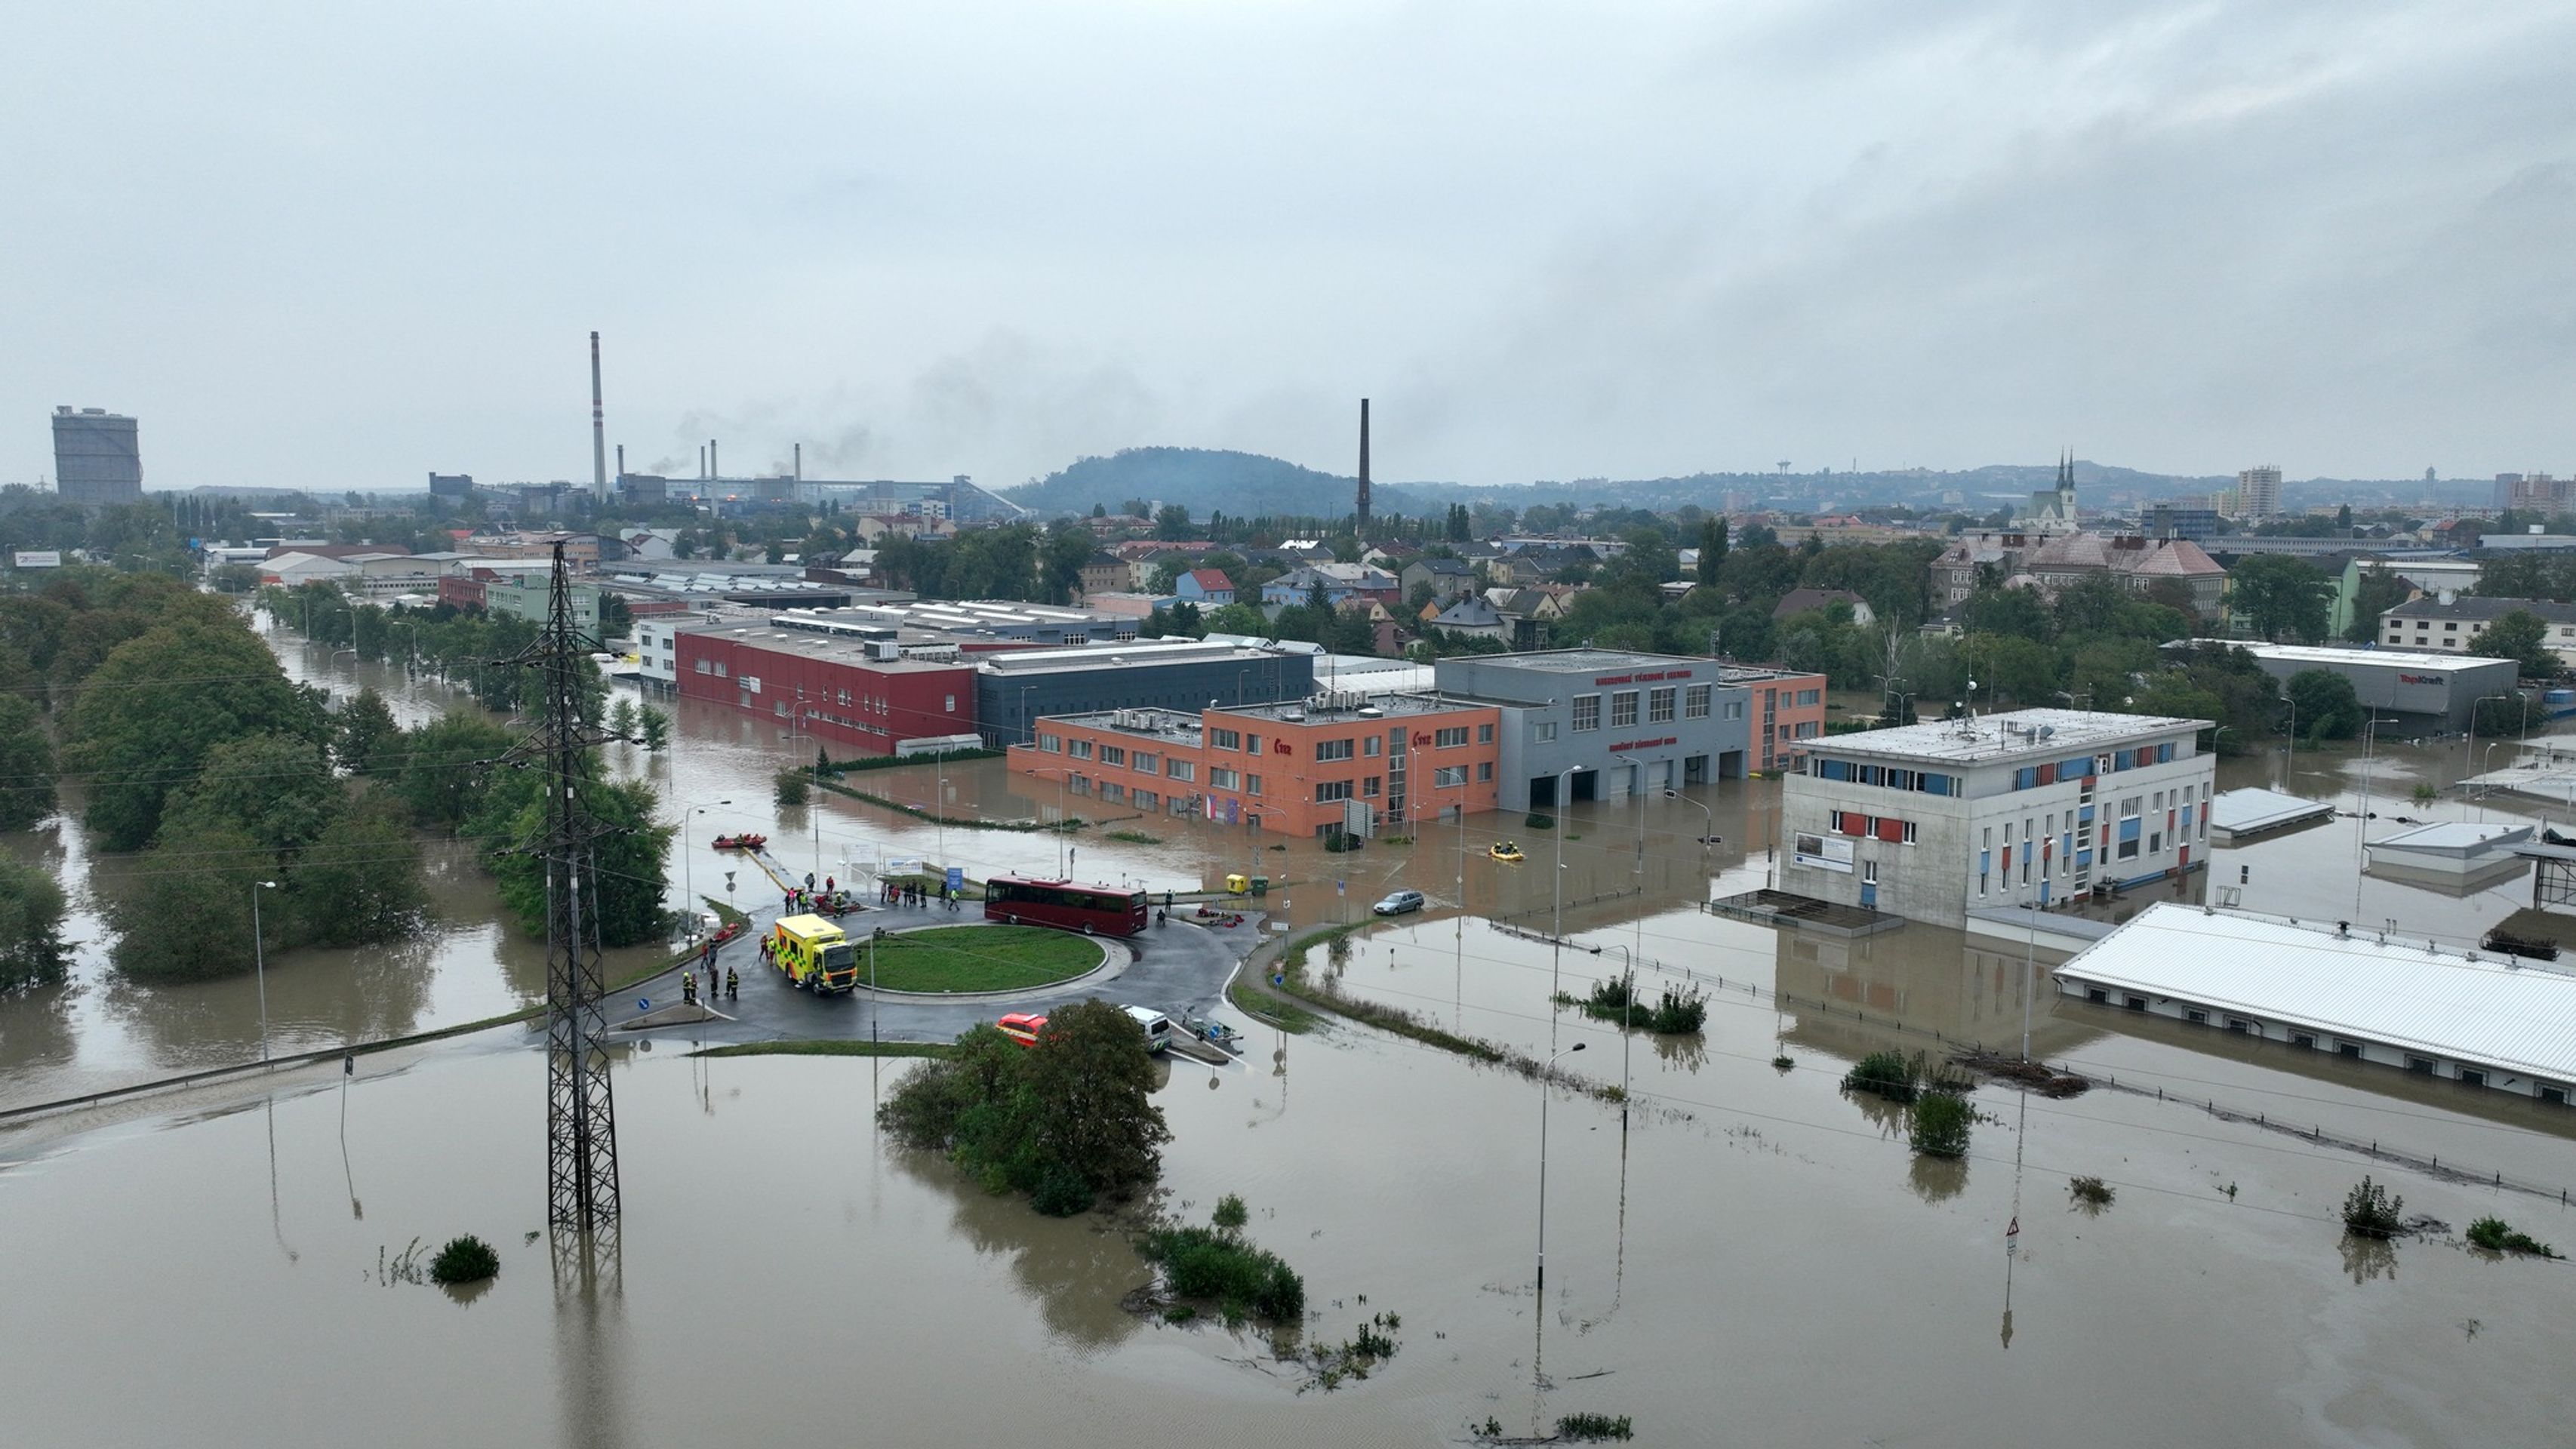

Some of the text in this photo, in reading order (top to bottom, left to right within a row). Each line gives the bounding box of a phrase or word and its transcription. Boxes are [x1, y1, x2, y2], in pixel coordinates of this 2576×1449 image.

[2400, 675, 2444, 685] TopKraft
[1417, 735, 1431, 746] 112
[1279, 743, 1291, 755] 112
